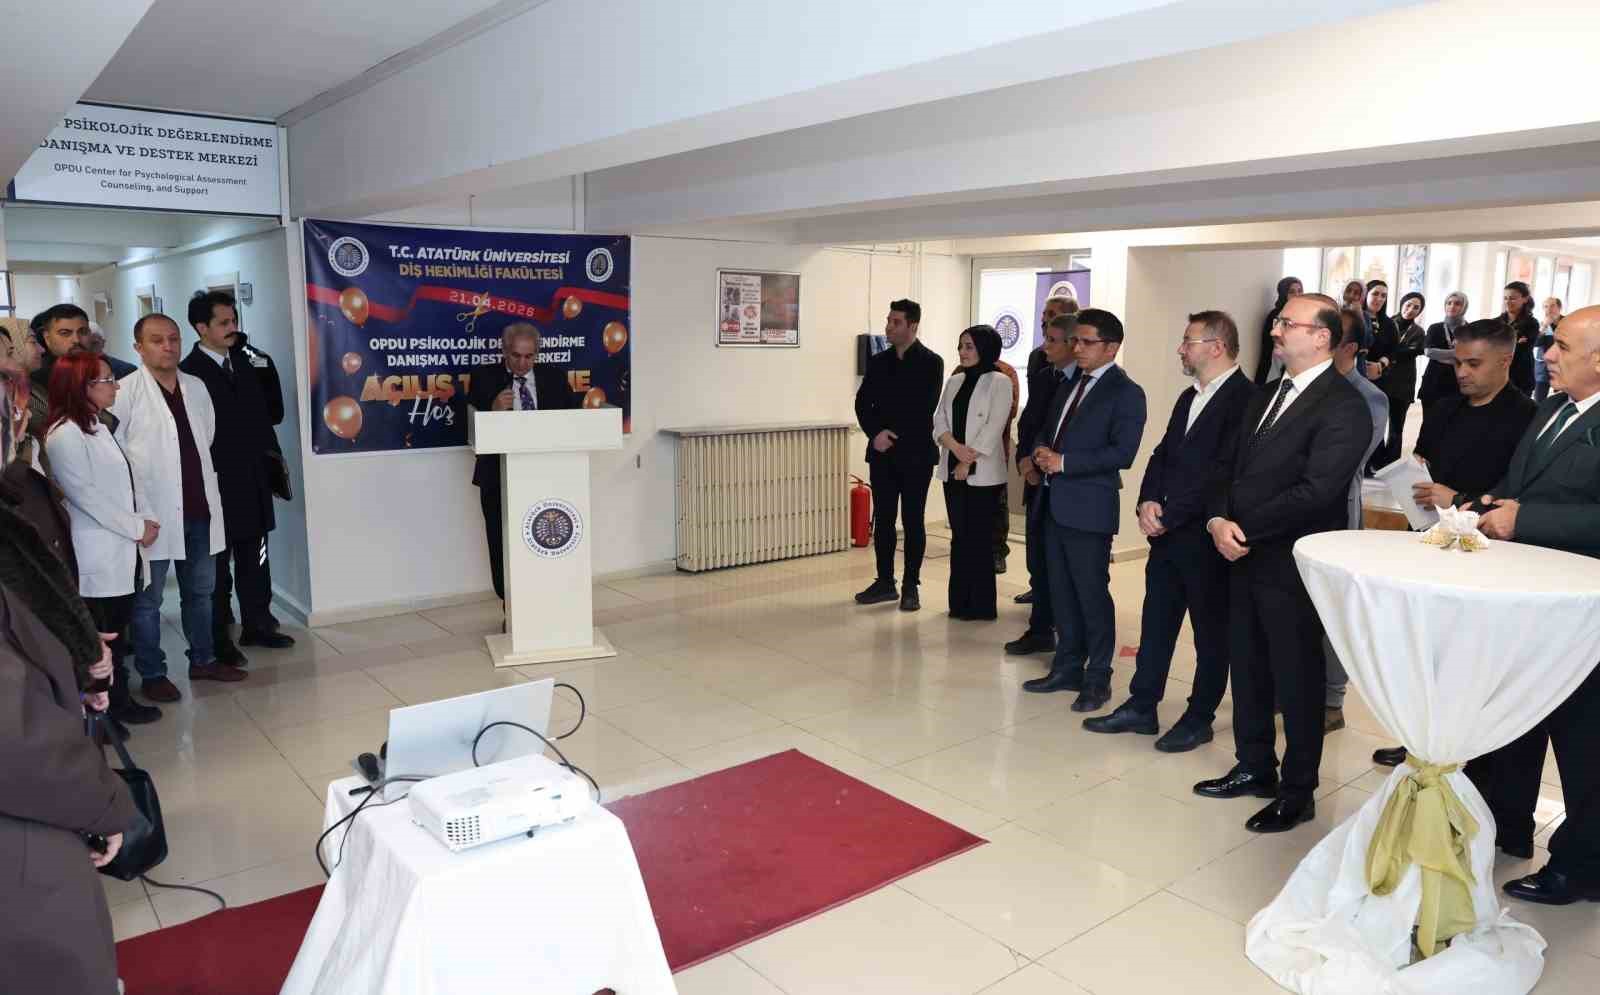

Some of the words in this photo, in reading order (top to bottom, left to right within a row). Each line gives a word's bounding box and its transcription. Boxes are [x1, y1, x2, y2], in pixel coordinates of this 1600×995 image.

[64, 117, 153, 136] PSİKOLOJİK
[157, 127, 272, 148] DEĞERLENDİRME
[116, 144, 135, 156] VE
[140, 147, 194, 161] DESTEK
[199, 152, 258, 166] MERKEZİ
[54, 163, 82, 173] OPDU
[84, 166, 116, 176] Center
[119, 168, 132, 177] for
[134, 169, 194, 183] Psychological
[196, 174, 247, 185] Assessment
[100, 180, 154, 193] Counseling,
[156, 184, 173, 193] and
[174, 185, 209, 196] Support
[389, 245, 414, 258] T.C.
[416, 247, 480, 262] ATATÜRK
[483, 249, 571, 264] ÜNİVERSİTESİ
[399, 262, 423, 278] DİŞ
[425, 264, 493, 279] HEKİMLİĞİ
[495, 266, 564, 280] FAKÜLTESİ
[369, 337, 407, 350] OPDU
[410, 335, 487, 350] PSİKOLOJİK
[387, 354, 448, 368] DANIŞMA
[451, 353, 469, 366] VE
[471, 353, 503, 366] DEST
[361, 373, 454, 406] AÇILIŞ
[408, 394, 455, 426] Hoş
